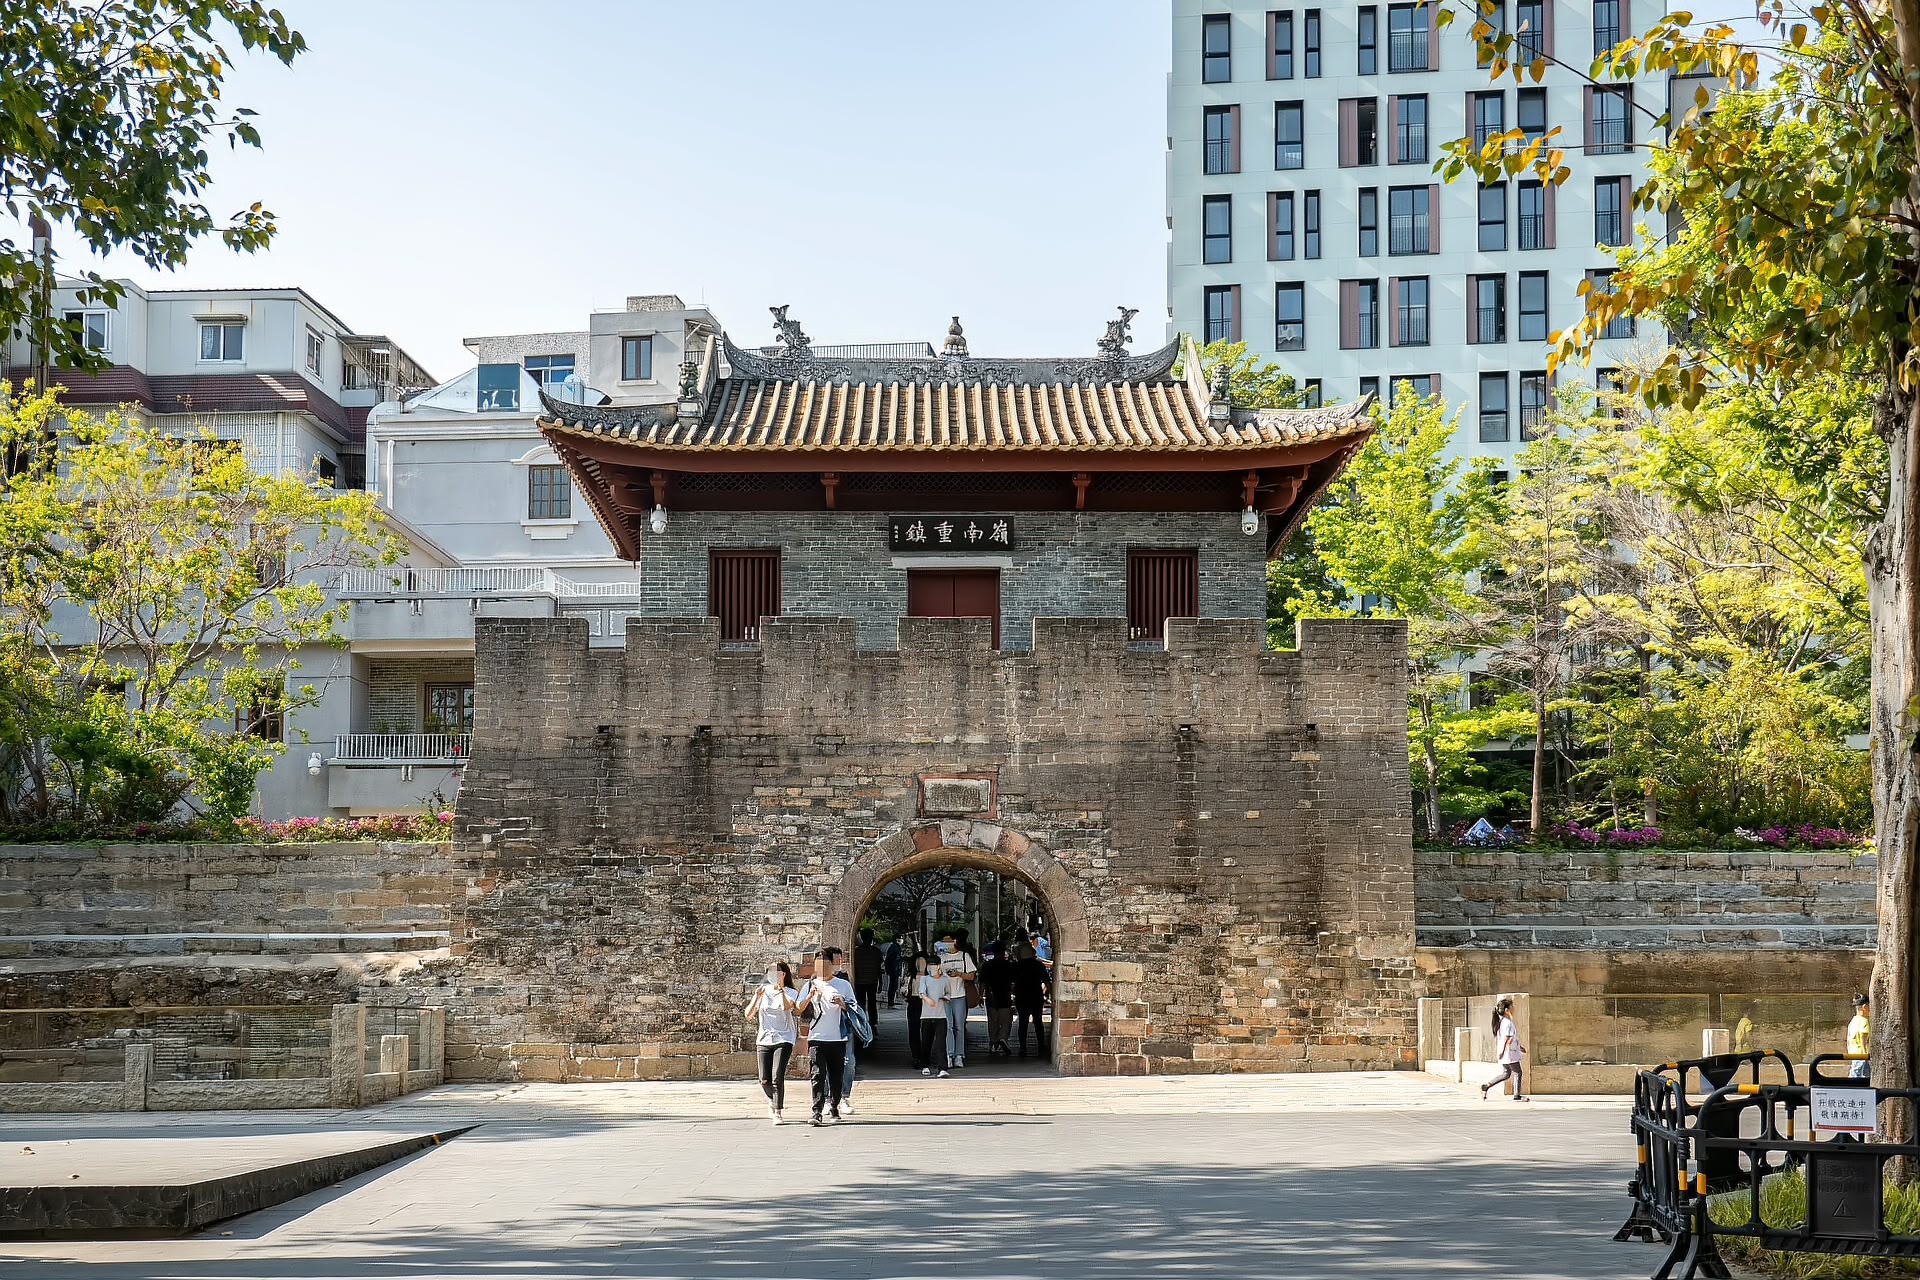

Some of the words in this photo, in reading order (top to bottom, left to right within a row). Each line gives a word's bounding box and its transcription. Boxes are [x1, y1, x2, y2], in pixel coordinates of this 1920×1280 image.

[1819, 1097, 1866, 1109] 升级改造中
